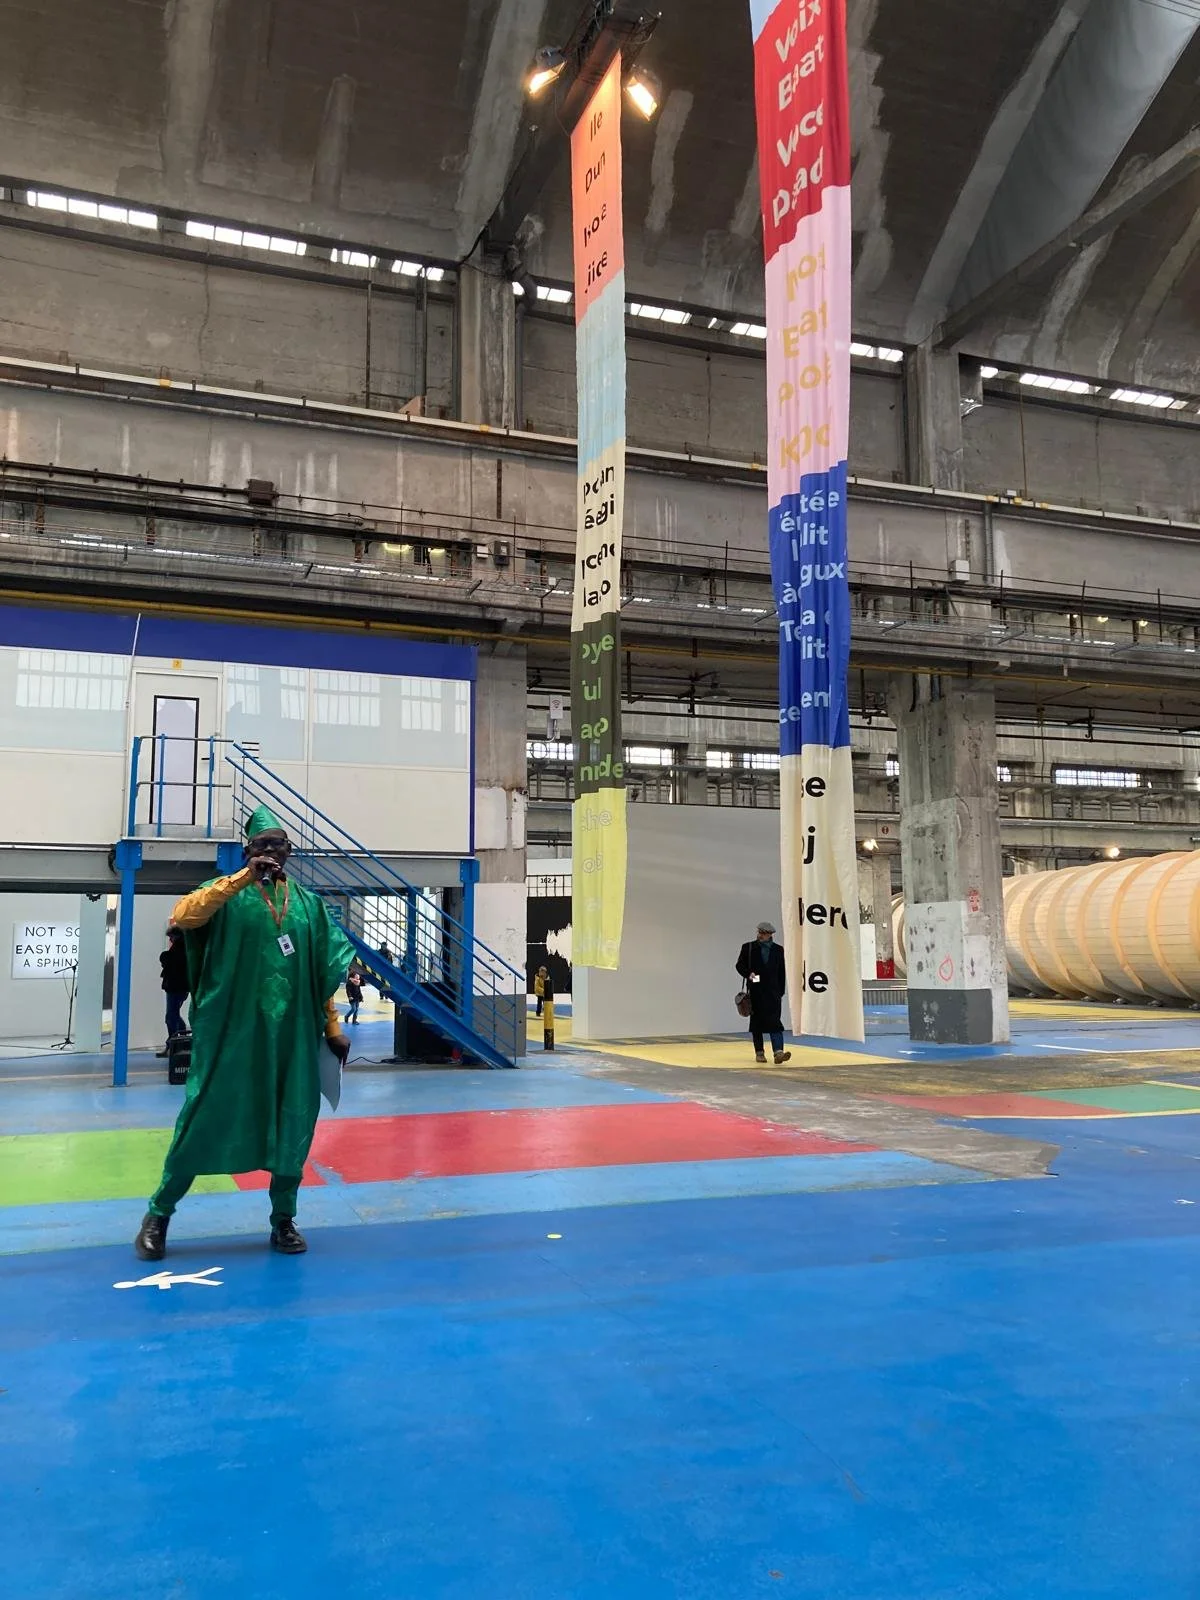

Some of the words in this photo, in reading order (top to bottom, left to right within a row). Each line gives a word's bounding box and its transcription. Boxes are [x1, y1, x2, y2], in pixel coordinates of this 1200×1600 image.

[800, 776, 826, 798] e
[25, 926, 56, 937] NOT
[15, 944, 51, 955] EASY
[56, 944, 68, 954] TO
[23, 958, 31, 968] A
